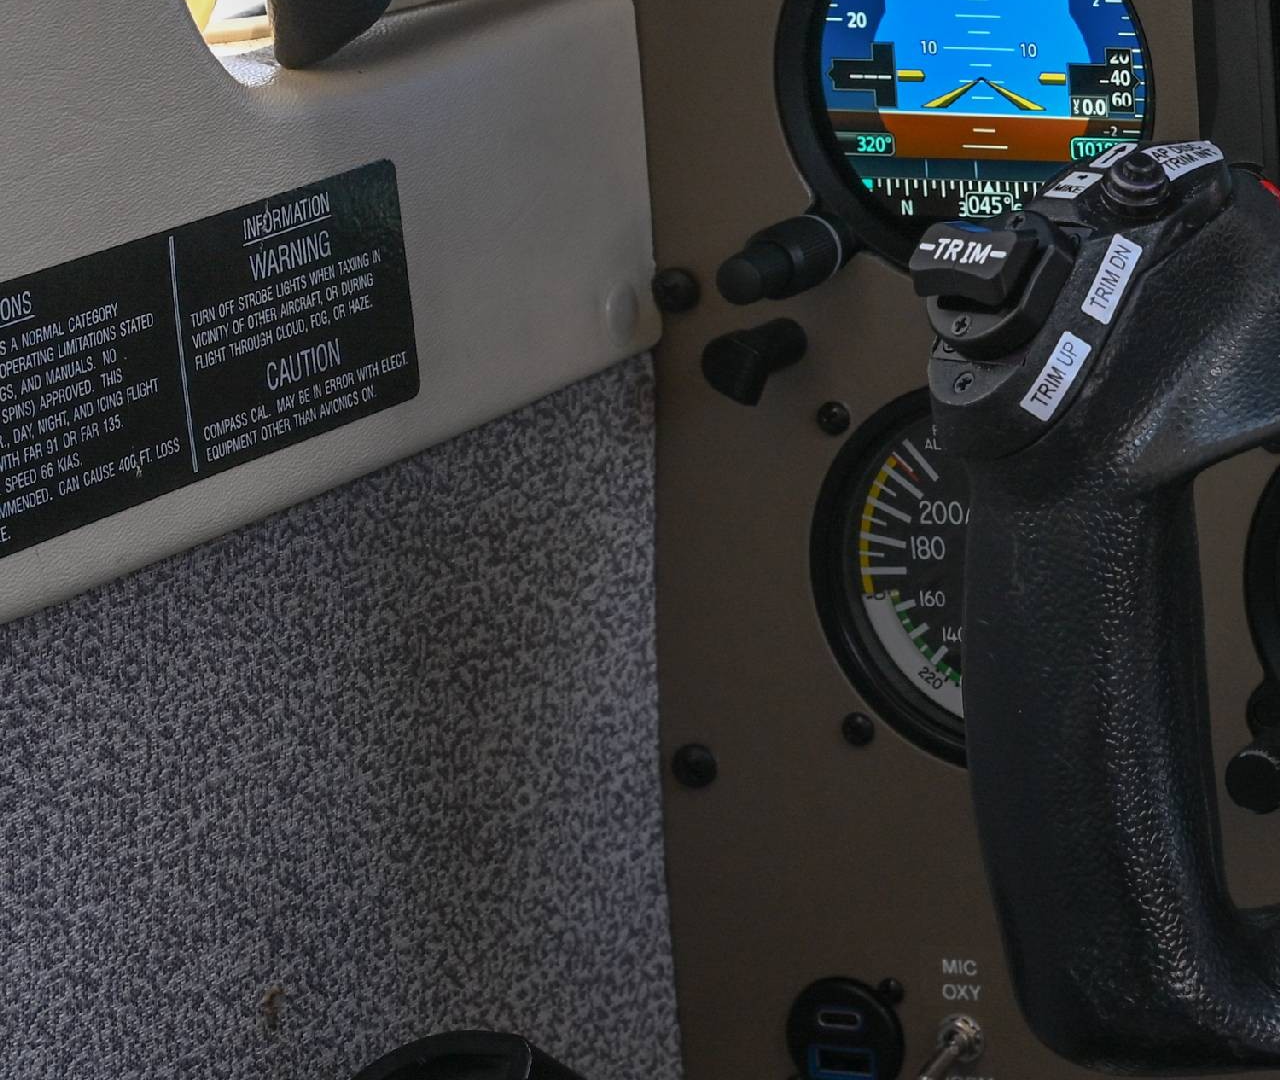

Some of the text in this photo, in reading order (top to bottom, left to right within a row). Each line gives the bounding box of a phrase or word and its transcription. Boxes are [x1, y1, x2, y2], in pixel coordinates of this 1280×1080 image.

[243, 192, 330, 240] INFORMATION
[249, 230, 331, 281] WARNING
[1089, 245, 1132, 310] TRIM DN
[266, 338, 341, 391] CAUTION
[1030, 341, 1078, 405] TRIM UP
[942, 959, 977, 976] MIC
[942, 984, 981, 1001] OXY
